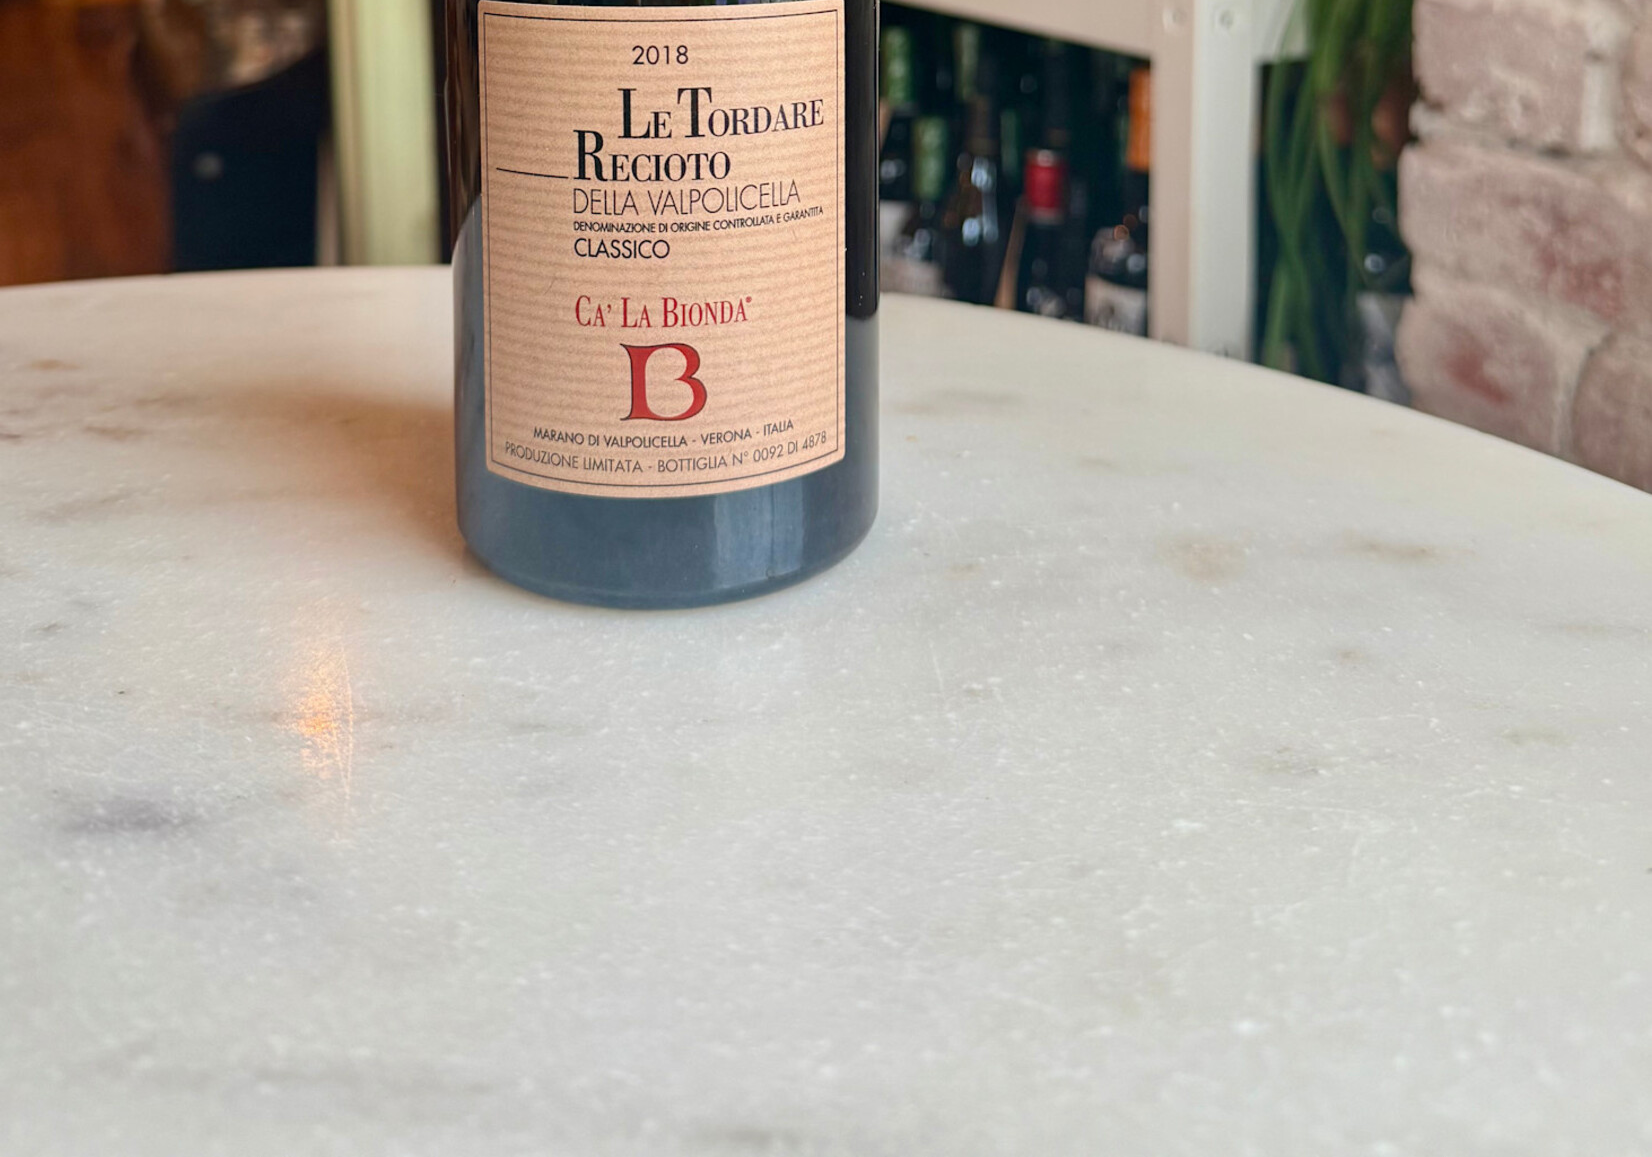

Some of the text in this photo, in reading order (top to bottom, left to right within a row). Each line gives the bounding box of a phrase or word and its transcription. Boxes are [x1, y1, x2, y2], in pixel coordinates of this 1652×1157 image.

[632, 45, 689, 65] 2018
[618, 87, 824, 139] LE TORDARE
[573, 129, 731, 181] RECIOTO
[574, 180, 800, 216] DELLA VALPOLICELLA
[574, 221, 656, 233] DENOMINAZIONE
[659, 222, 668, 232] DI
[670, 220, 710, 232] ORIGINE
[713, 216, 774, 230] CONTROLLATA
[777, 214, 781, 223] E
[574, 238, 670, 259] CLASSICO
[621, 297, 651, 328] LA
[533, 427, 585, 445] MARANO
[588, 435, 599, 447] DI
[603, 434, 688, 448] VALPOLICELLA
[700, 427, 752, 444] VERONA
[763, 420, 793, 436] ITALIA
[505, 441, 578, 469] PRODUZIONE
[583, 458, 643, 473] LIMITATA
[658, 456, 727, 473] BOTTIGLIA
[753, 445, 784, 463] 0092
[788, 443, 799, 455] DI
[802, 430, 826, 451] 4878
